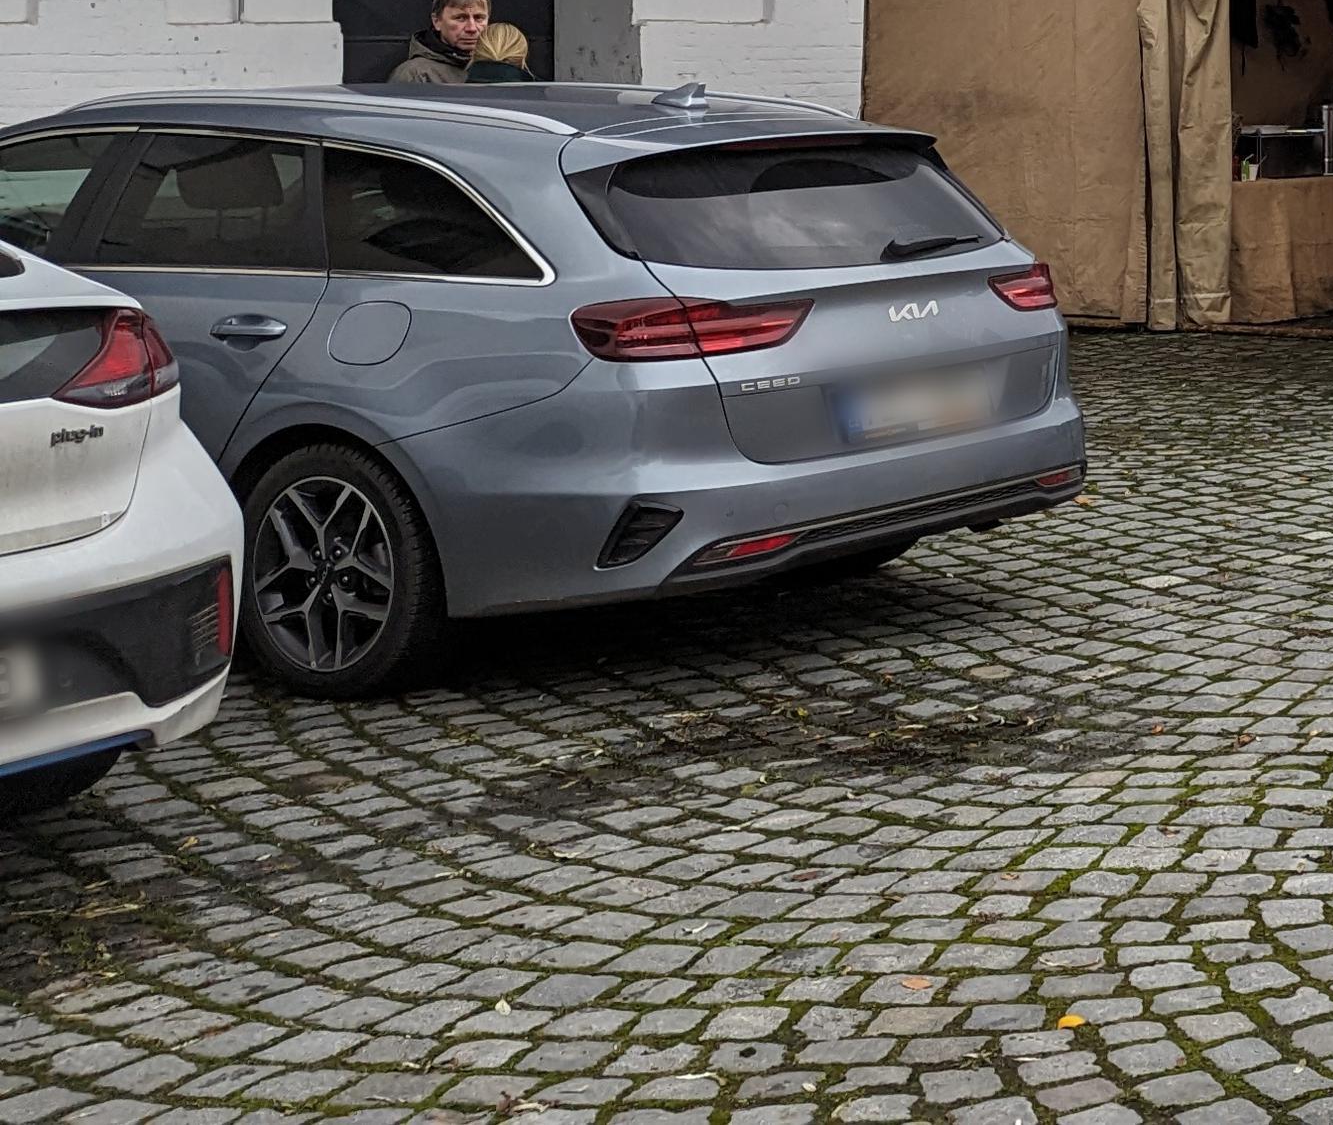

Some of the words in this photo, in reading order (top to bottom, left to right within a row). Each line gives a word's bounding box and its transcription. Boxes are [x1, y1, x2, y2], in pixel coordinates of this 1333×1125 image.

[889, 300, 939, 322] KIA
[741, 376, 801, 392] CEED
[50, 424, 104, 448] plug-in
